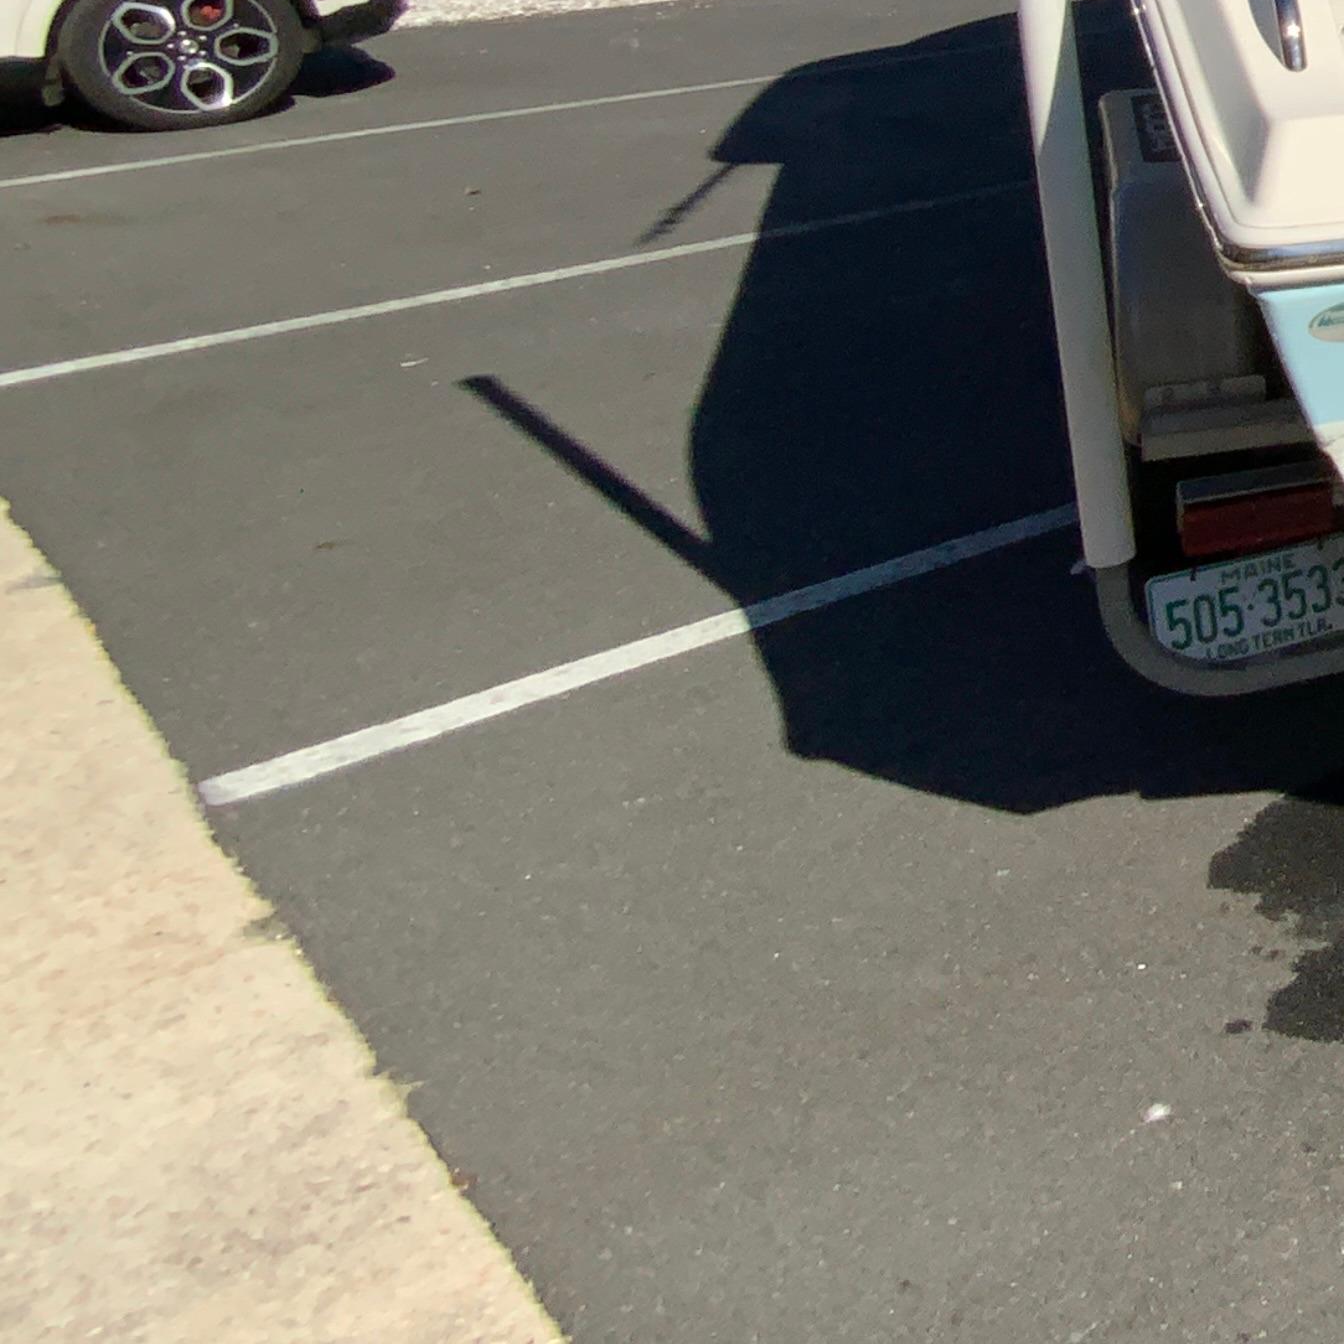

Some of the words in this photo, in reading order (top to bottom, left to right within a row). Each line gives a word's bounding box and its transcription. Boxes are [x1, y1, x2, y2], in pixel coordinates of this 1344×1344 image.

[1220, 553, 1297, 585] MAINE
[1206, 637, 1250, 660] LONG
[1252, 626, 1295, 648] TERM
